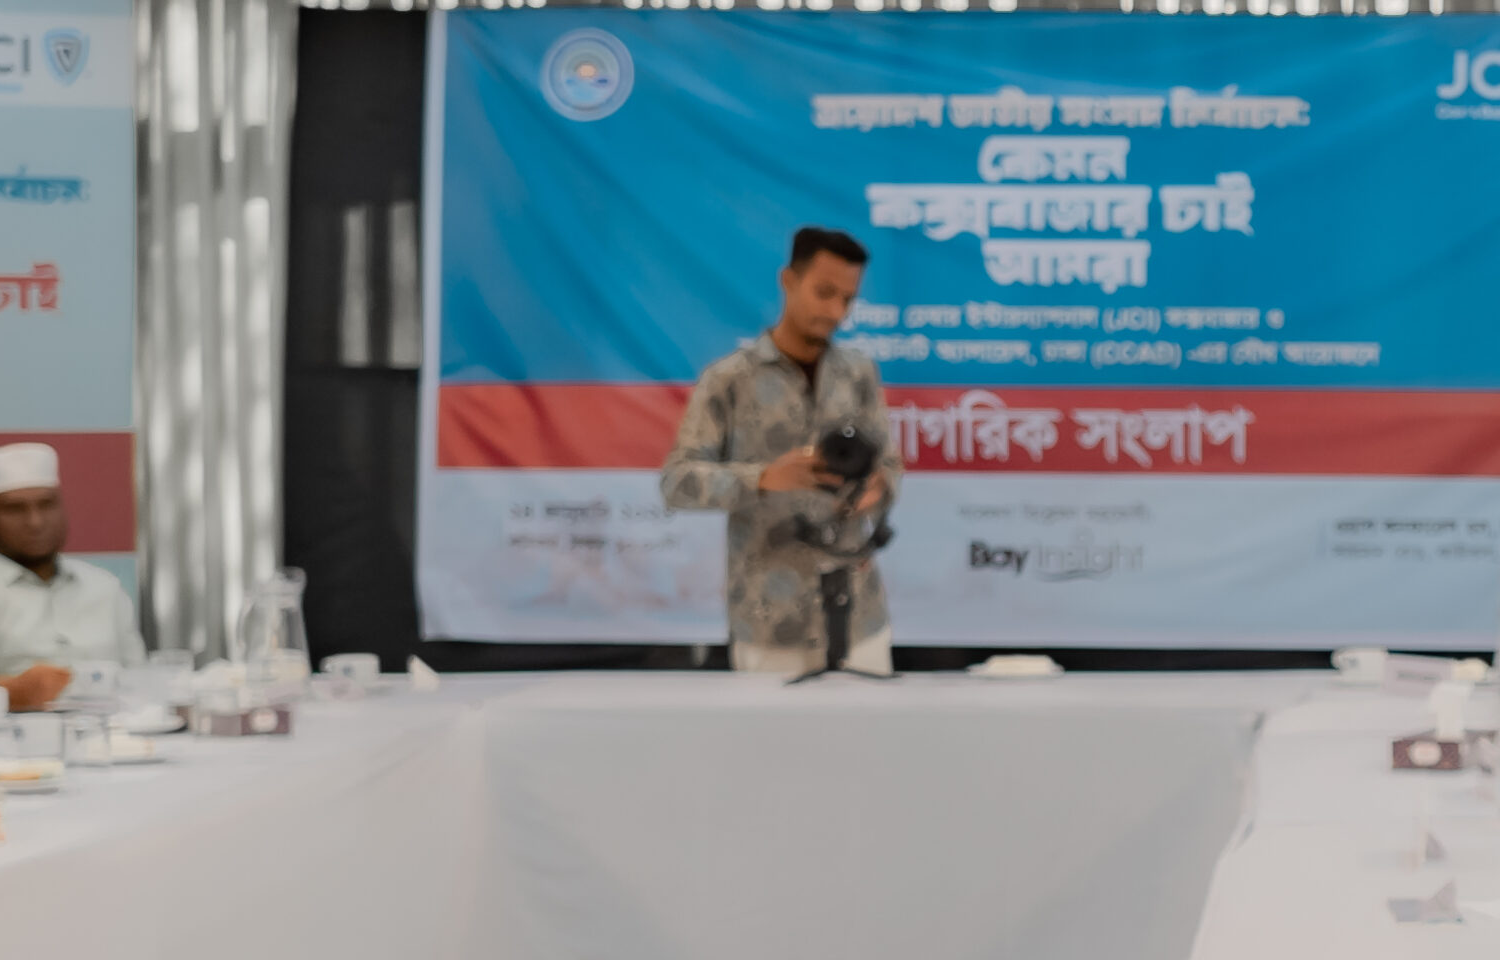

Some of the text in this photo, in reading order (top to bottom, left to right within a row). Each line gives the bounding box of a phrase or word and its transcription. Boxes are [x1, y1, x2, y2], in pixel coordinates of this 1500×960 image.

[948, 86, 1053, 131] জাতীয়
[1058, 96, 1166, 128] সংসদ
[978, 135, 1131, 183] কেমন
[865, 171, 1256, 241] কক্সবাজার চাই
[982, 239, 1152, 294] আমরা
[1103, 306, 1162, 334] (JCI)
[1071, 404, 1256, 468] সংলাপ
[969, 539, 1030, 575] Bay
